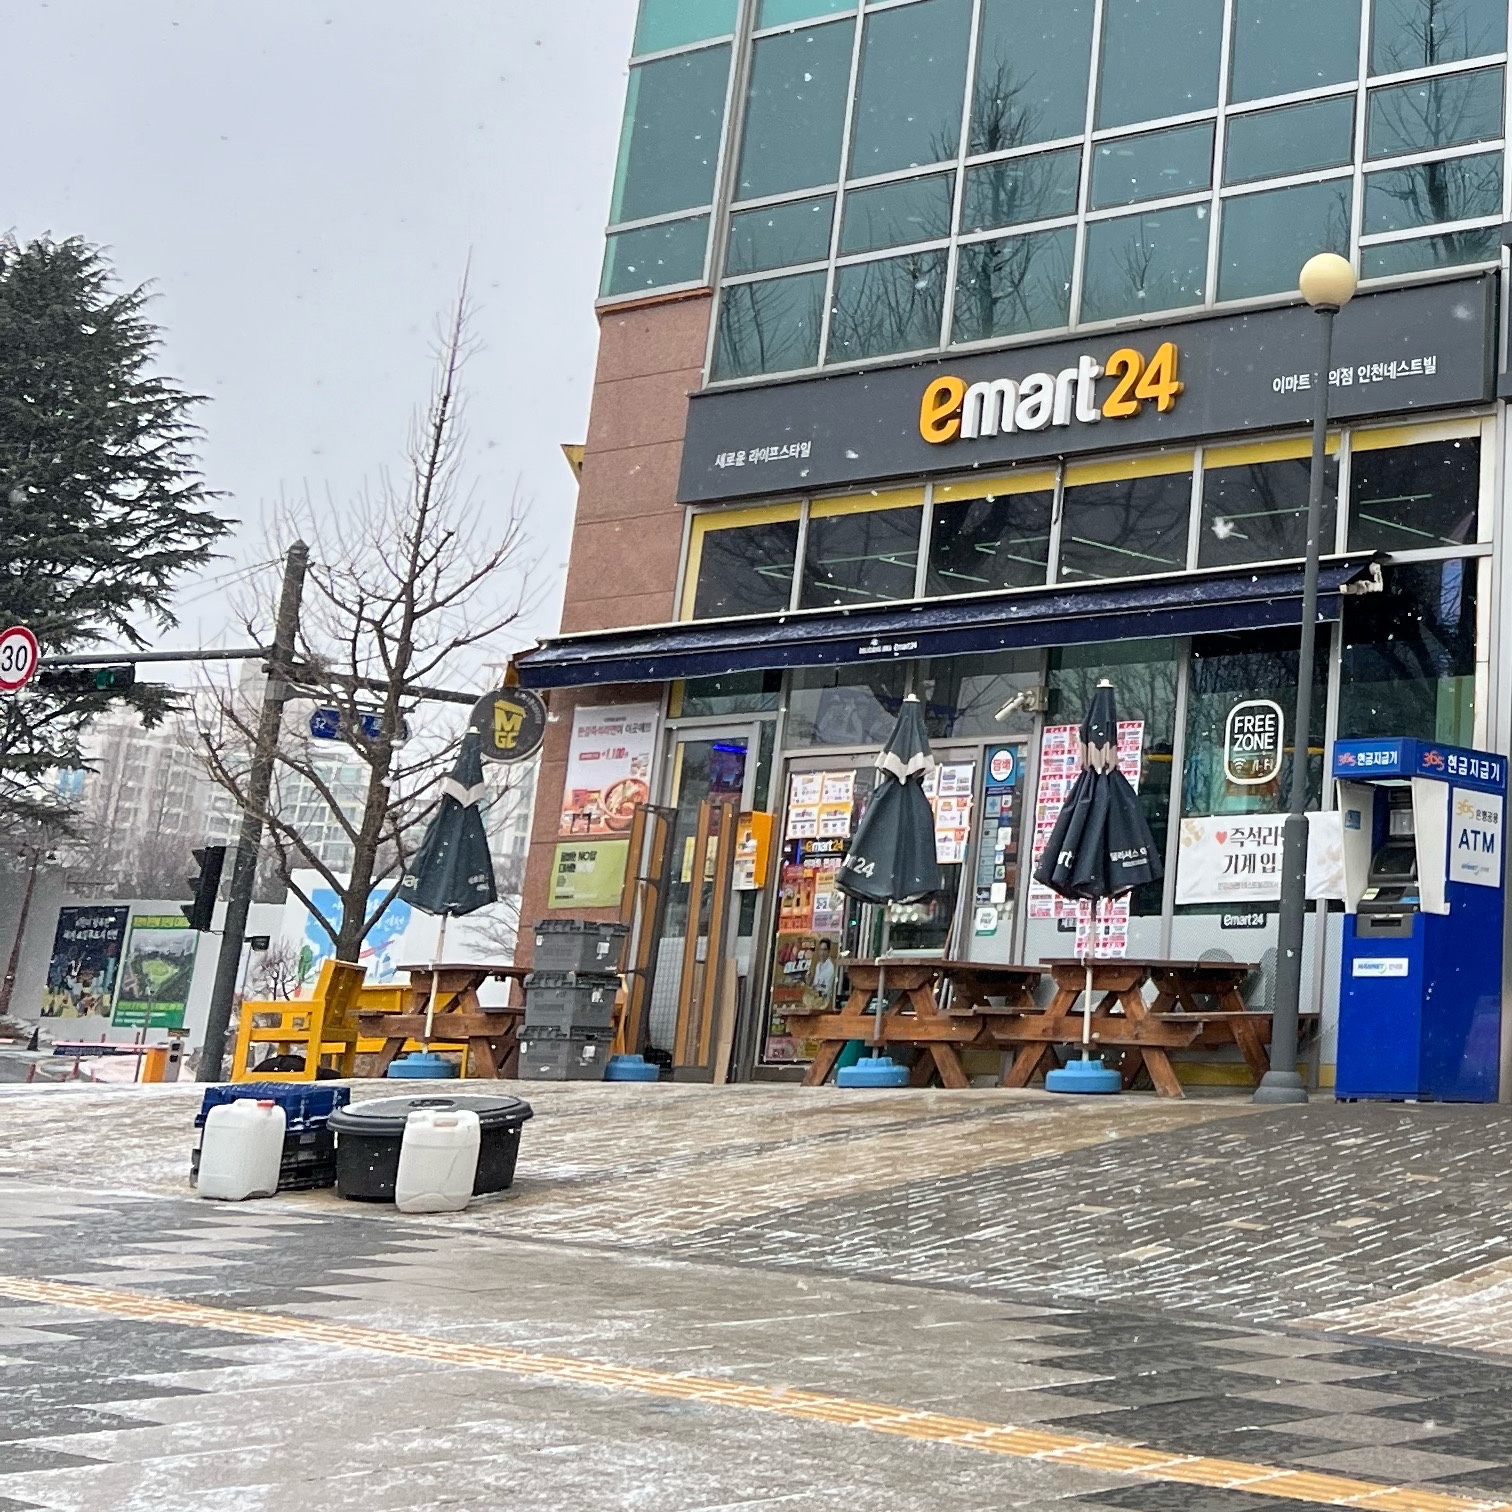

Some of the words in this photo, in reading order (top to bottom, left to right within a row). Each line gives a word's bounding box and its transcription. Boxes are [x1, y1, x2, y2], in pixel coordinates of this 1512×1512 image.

[1272, 373, 1311, 394] 이마트
[1357, 355, 1437, 385] 인천네스트빌
[919, 342, 1184, 444] emart24
[748, 441, 811, 465] 라이프스타일
[1, 645, 28, 672] 30
[1234, 713, 1276, 733] FREE
[1233, 732, 1275, 751] ZONE
[1357, 750, 1398, 767] 현금지급기
[1447, 754, 1500, 782] 현금지급기
[1229, 826, 1286, 848] 즉석라
[1458, 828, 1495, 854] ATM
[1222, 853, 1256, 875] 기계
[1260, 852, 1283, 874] 입
[1223, 913, 1264, 926] emart24
